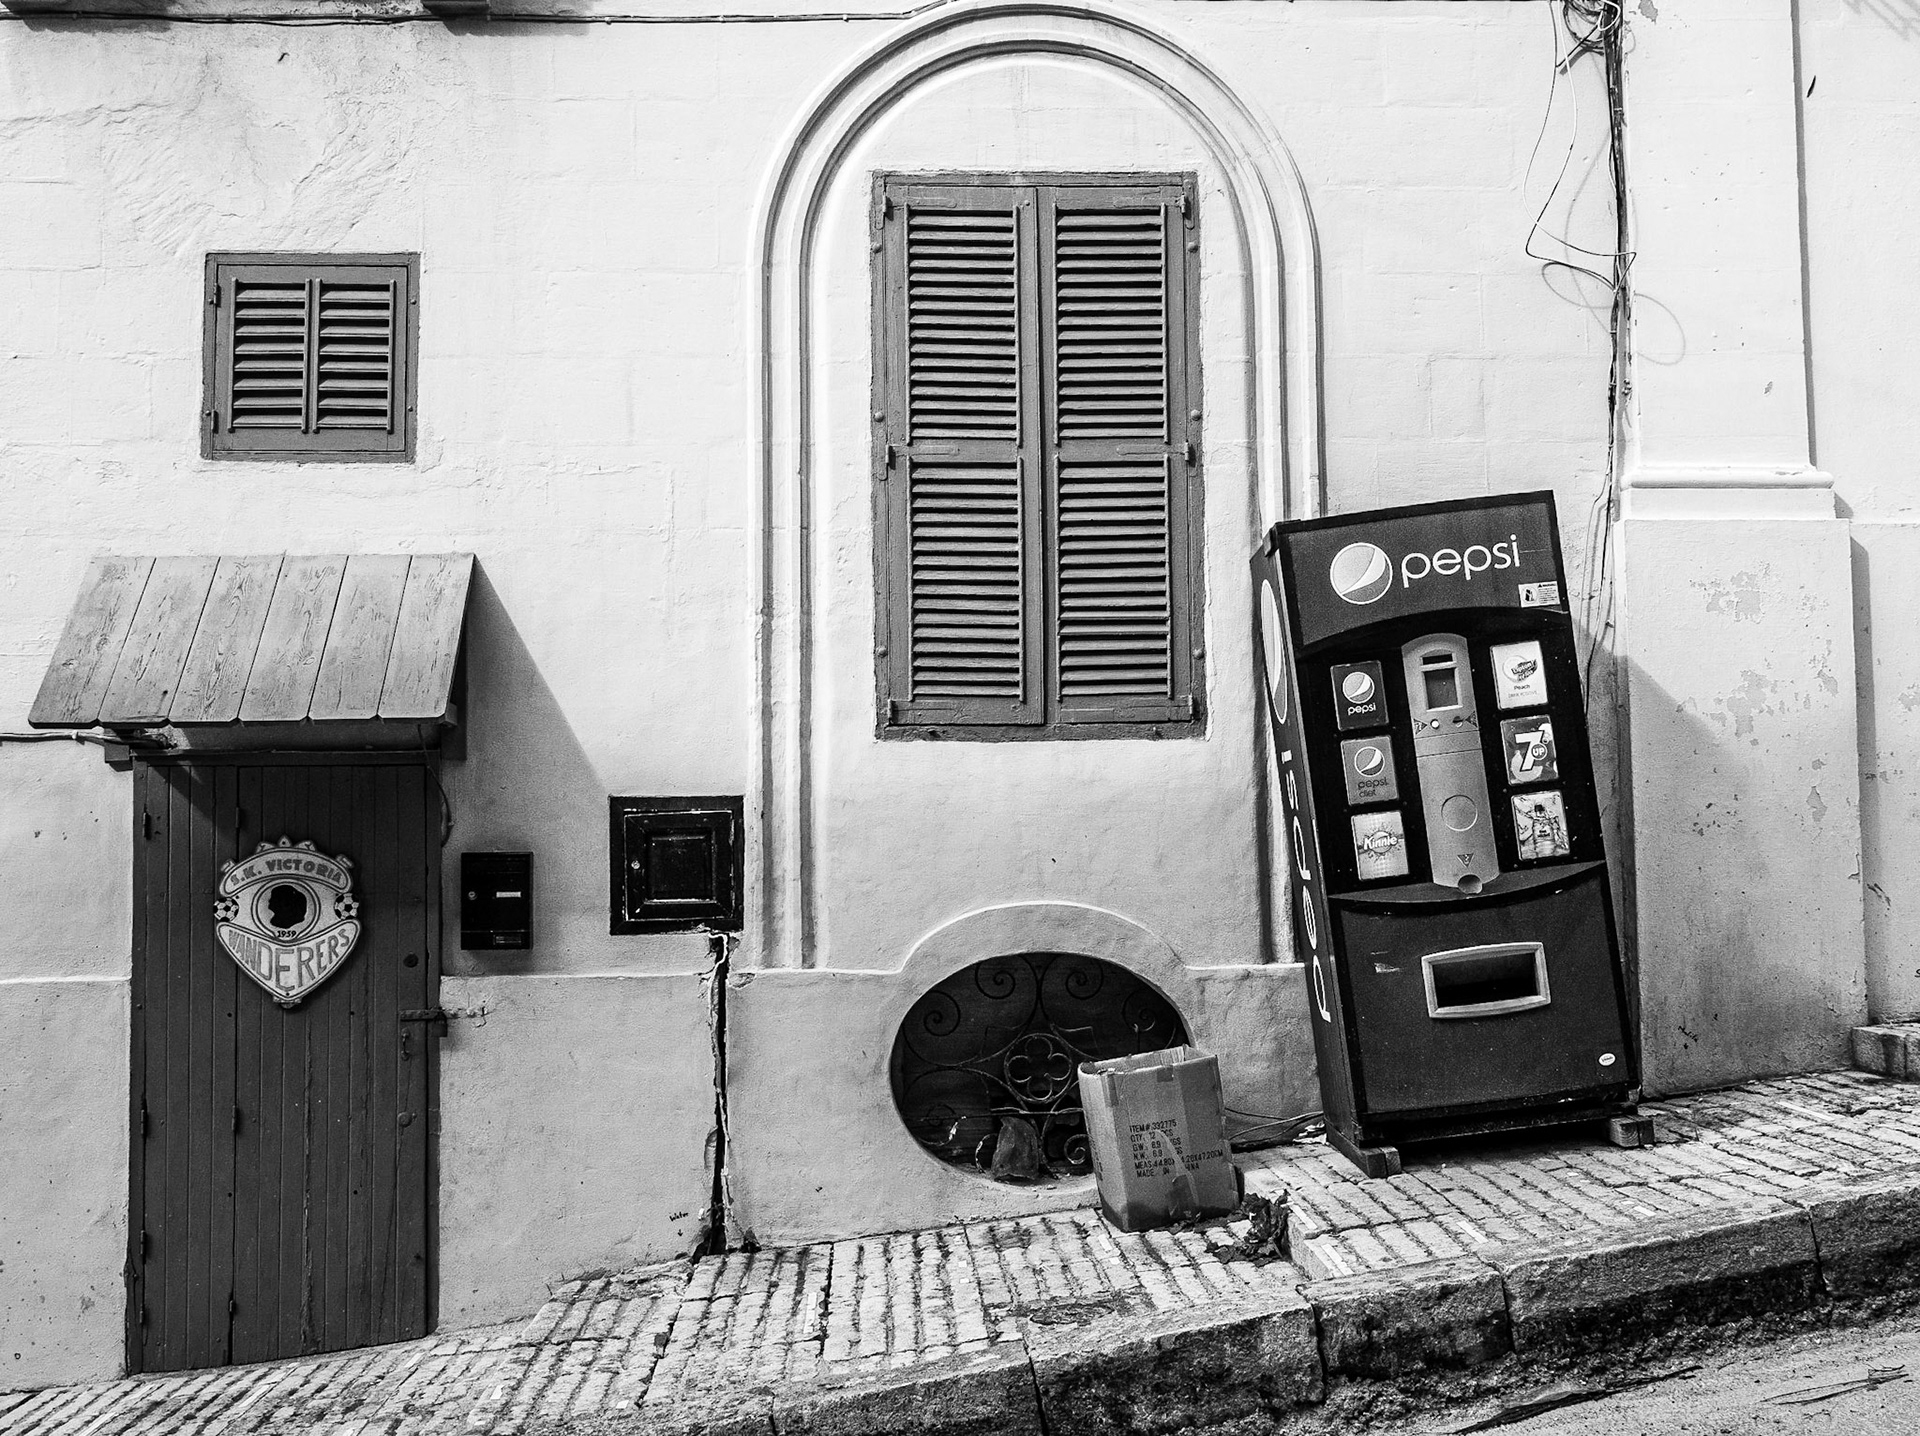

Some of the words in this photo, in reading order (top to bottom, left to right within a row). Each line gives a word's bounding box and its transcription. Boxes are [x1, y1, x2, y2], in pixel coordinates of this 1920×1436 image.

[1401, 533, 1520, 588] pepsi
[1347, 702, 1377, 716] pepsi
[1532, 747, 1545, 757] UP
[1358, 776, 1387, 790] pepsi
[1363, 835, 1398, 850] Kinnie
[265, 858, 343, 885] VICTORIA
[277, 930, 297, 938] 1959
[228, 929, 350, 991] WANDERERS
